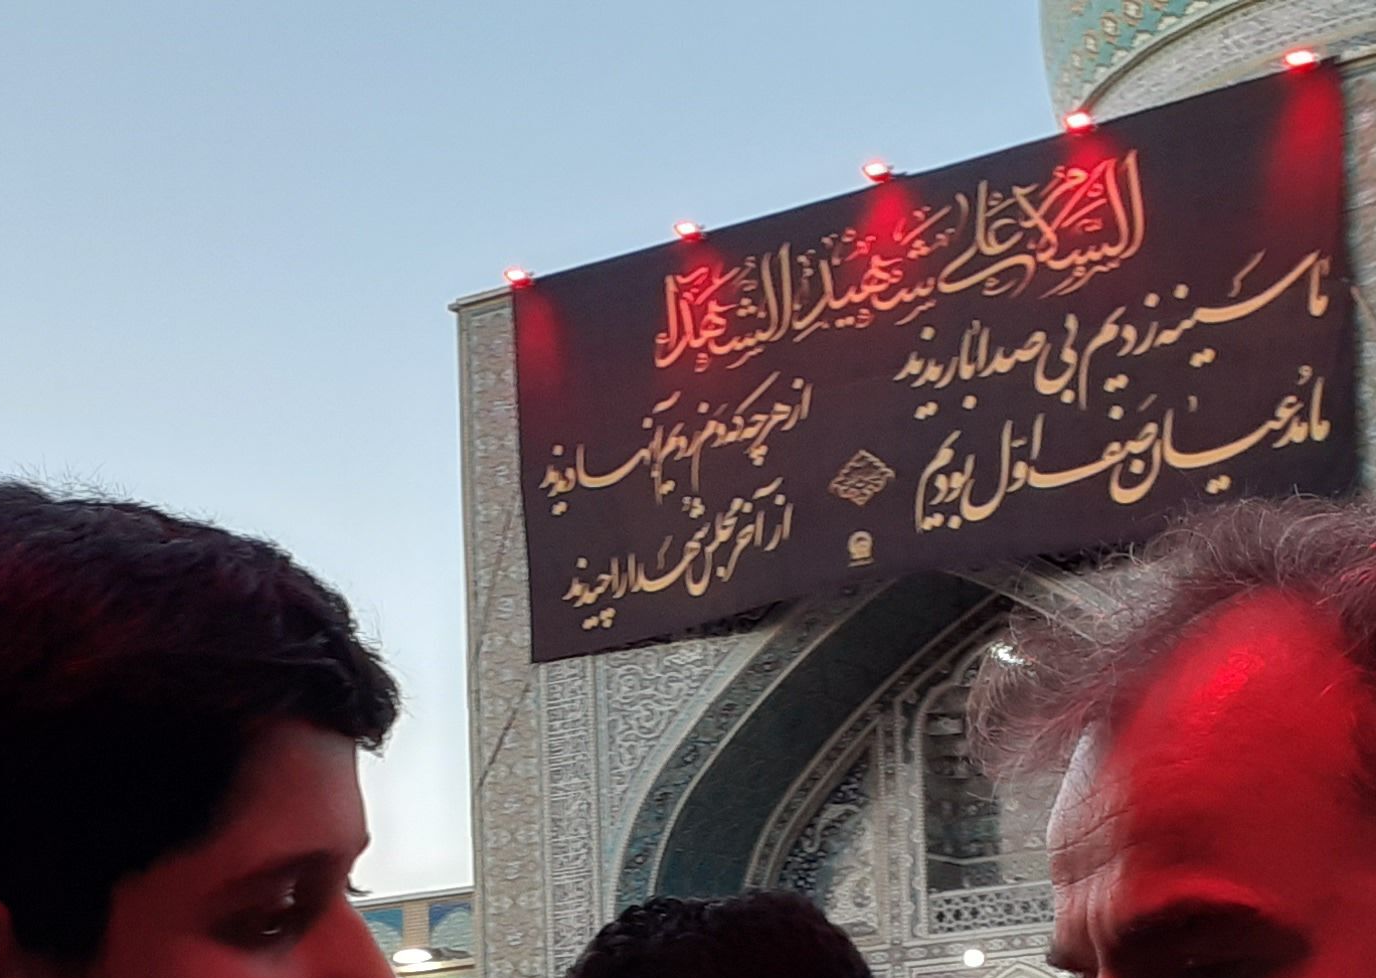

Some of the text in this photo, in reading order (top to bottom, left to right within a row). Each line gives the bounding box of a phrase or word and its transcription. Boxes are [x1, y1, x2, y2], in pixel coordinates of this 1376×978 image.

[892, 249, 1332, 420] ما سینه زدیم بی صدا باریدند
[780, 377, 814, 432] از
[1308, 376, 1331, 441] ما
[763, 493, 795, 552] از
[915, 428, 976, 535] بودیم
[720, 476, 785, 583] آخر
